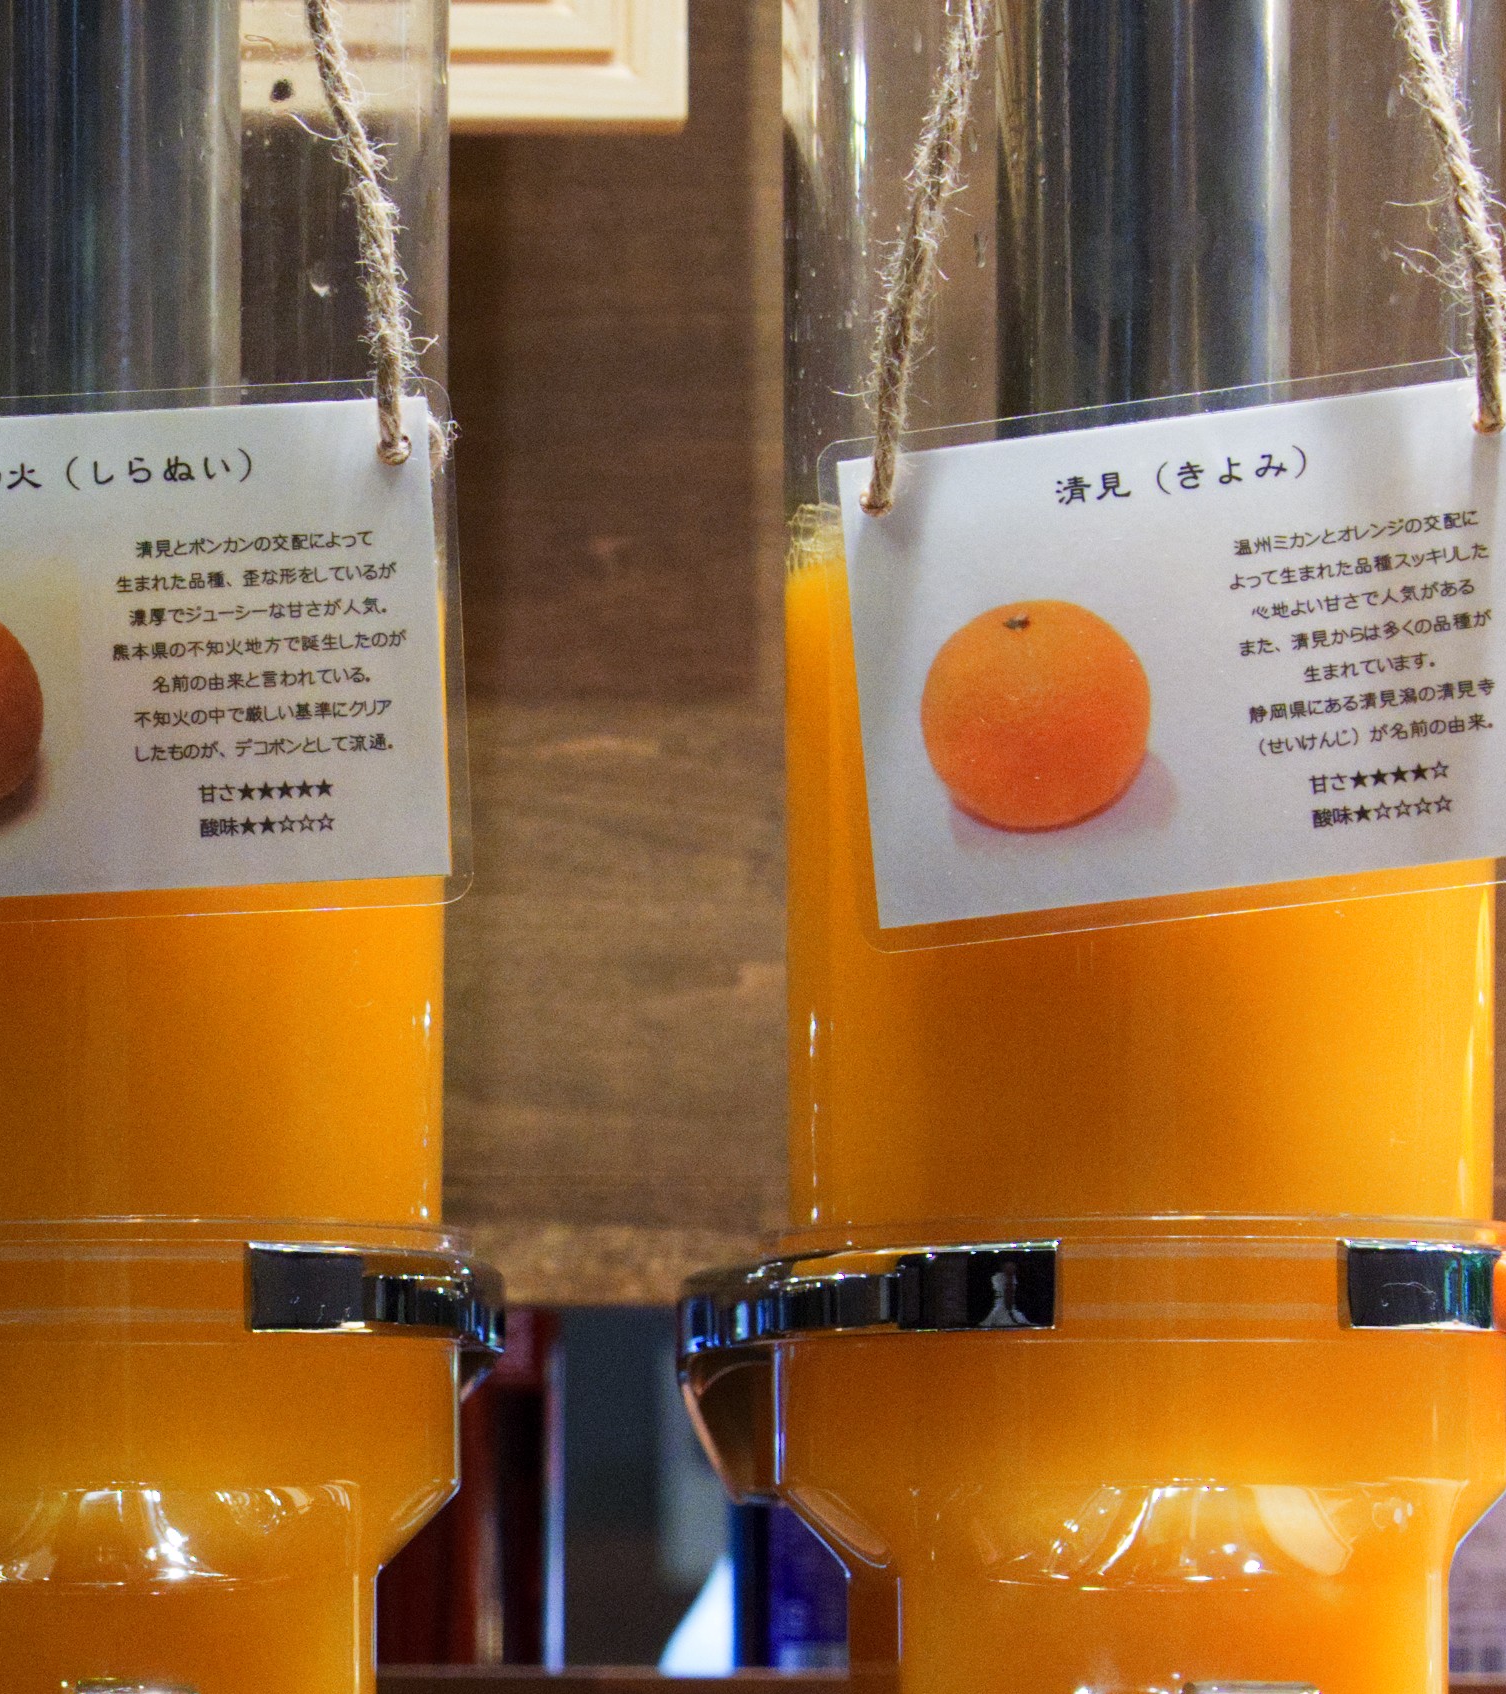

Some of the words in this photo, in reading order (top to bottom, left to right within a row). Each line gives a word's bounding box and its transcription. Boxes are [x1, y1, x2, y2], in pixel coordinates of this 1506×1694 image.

[135, 530, 372, 559] 清見とポンカンの交配によって
[1234, 509, 1480, 557] 温州ミカンとオレンジの交配に
[116, 561, 397, 594] 生まれた品種、歪な形をしているが
[1229, 542, 1490, 591] よって生まれた品種スッキリした
[129, 597, 387, 627] 濃厚でジューシーな甘さが人気。
[1251, 577, 1476, 620] 心地よい甘さで人気がある
[111, 629, 406, 662] 熊本県の不知火地方で誕生したのが
[1240, 608, 1491, 657] また、清見からは多くの品種が
[152, 666, 371, 695] 名前の由来と言われている。
[1304, 651, 1436, 684] 生まれています。
[133, 699, 392, 729] 不知火の中で厳しい基準にクリア
